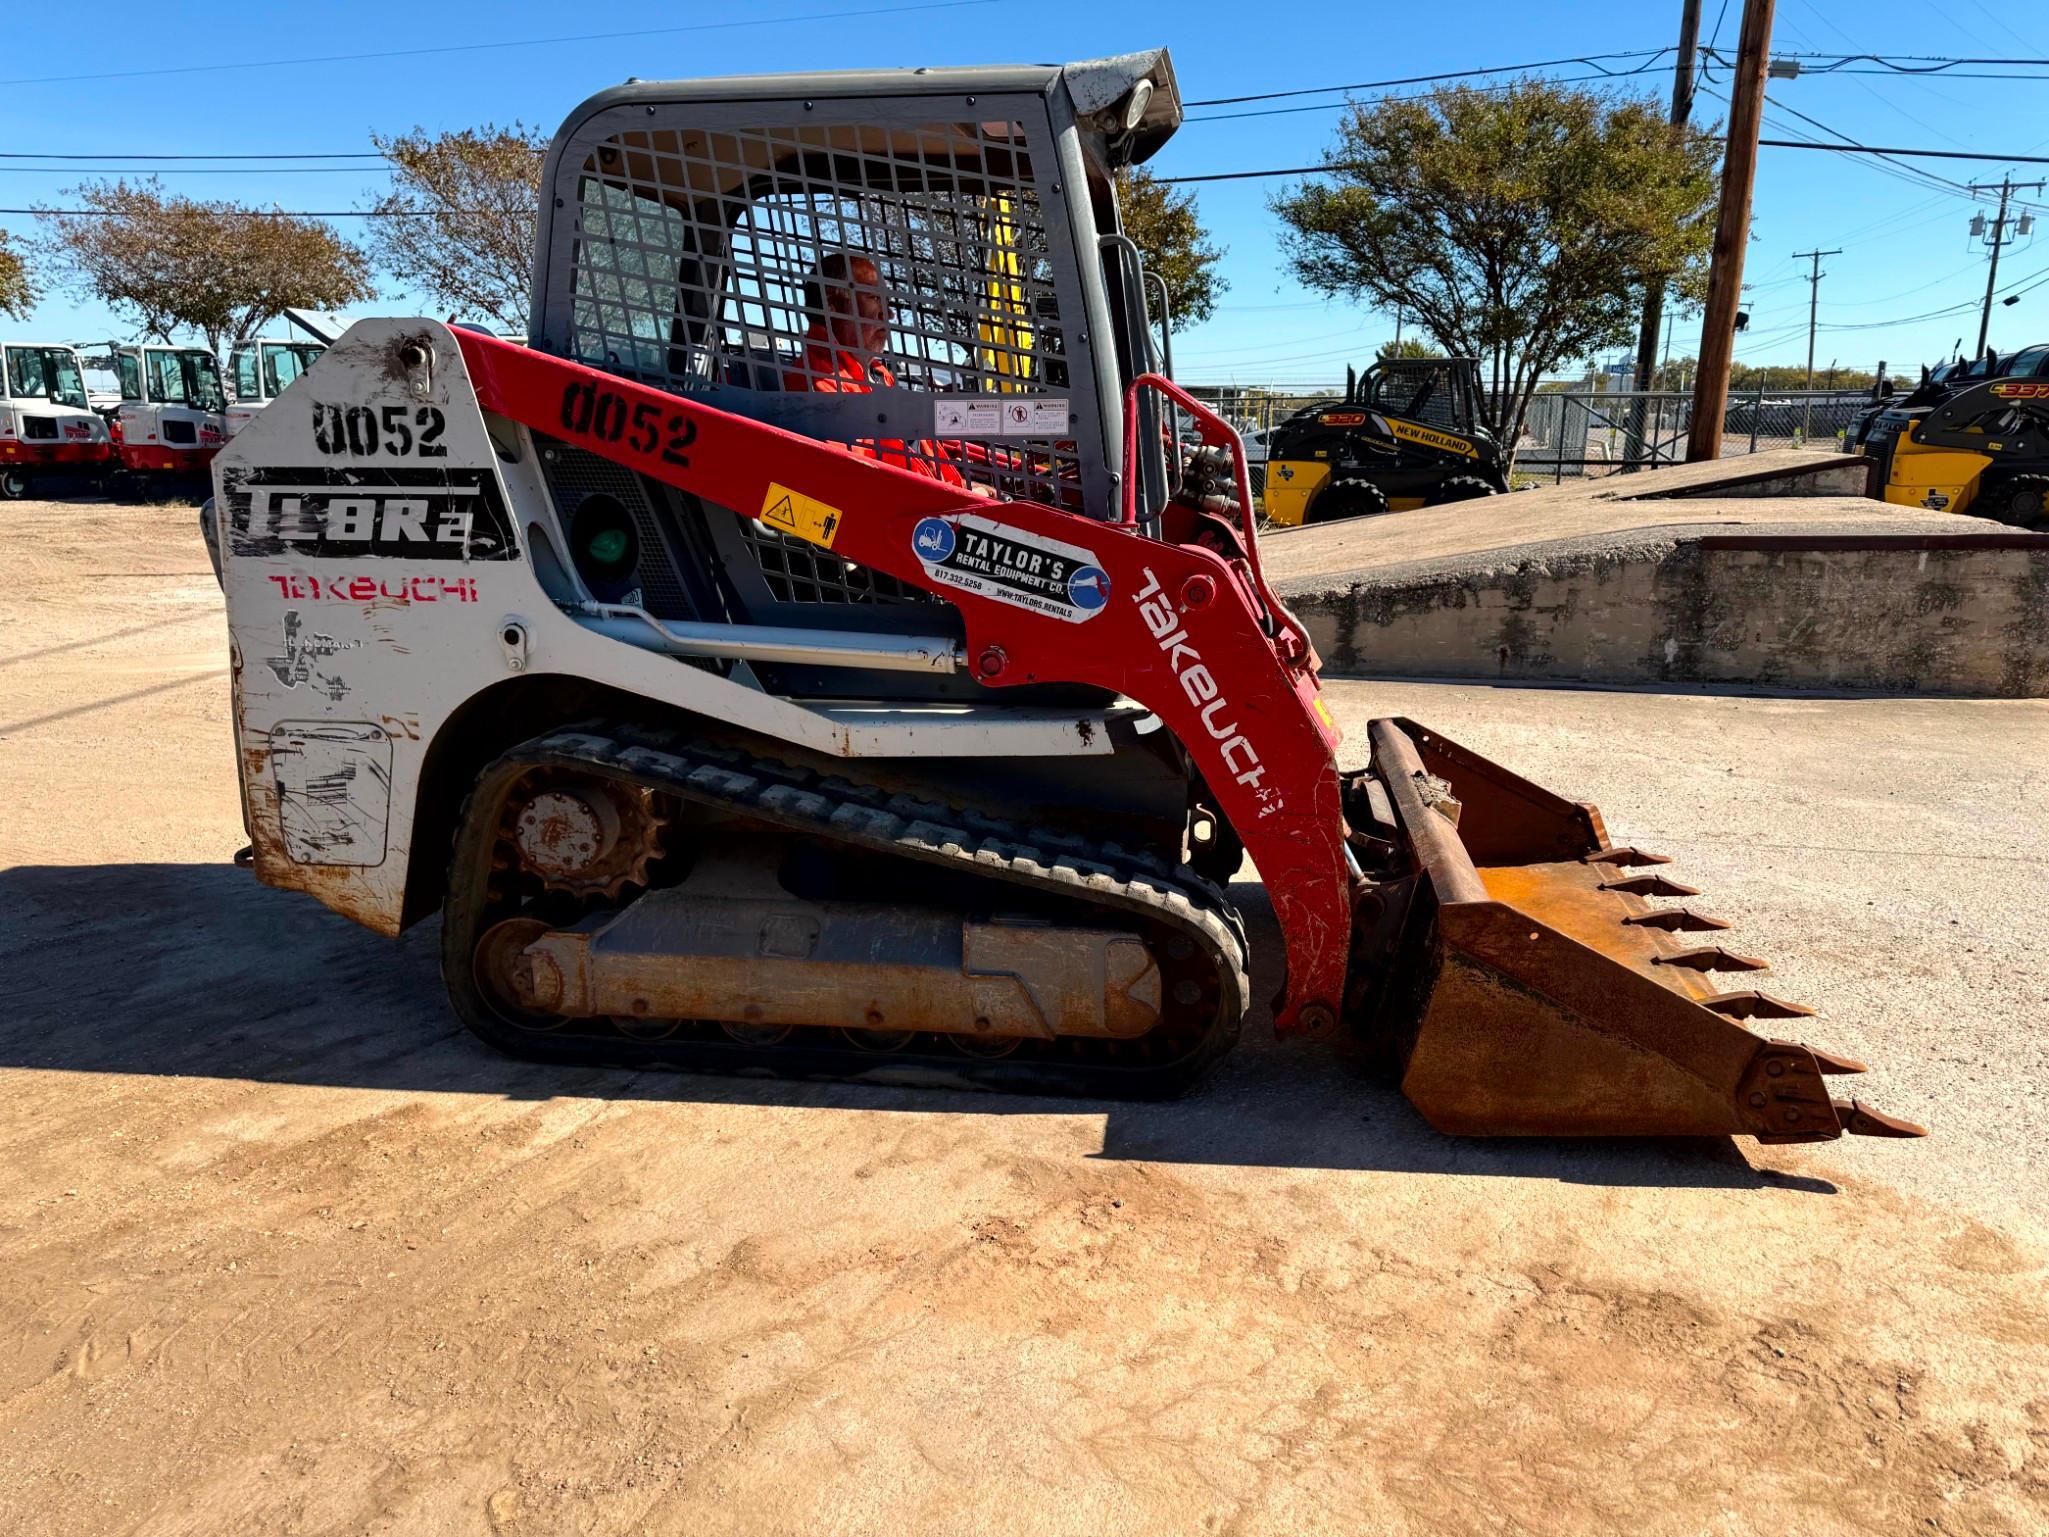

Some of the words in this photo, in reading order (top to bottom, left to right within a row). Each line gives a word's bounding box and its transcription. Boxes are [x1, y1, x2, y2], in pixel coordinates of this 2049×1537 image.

[312, 403, 448, 457] 0052
[560, 380, 698, 468] 0052
[1396, 424, 1420, 438] NEW
[1421, 431, 1467, 451] HOLLAND
[956, 552, 991, 572] RENTAL
[994, 564, 1047, 588] EQUIPMENT
[1049, 582, 1065, 595] CO.
[965, 533, 1065, 580] TAYLOR'S
